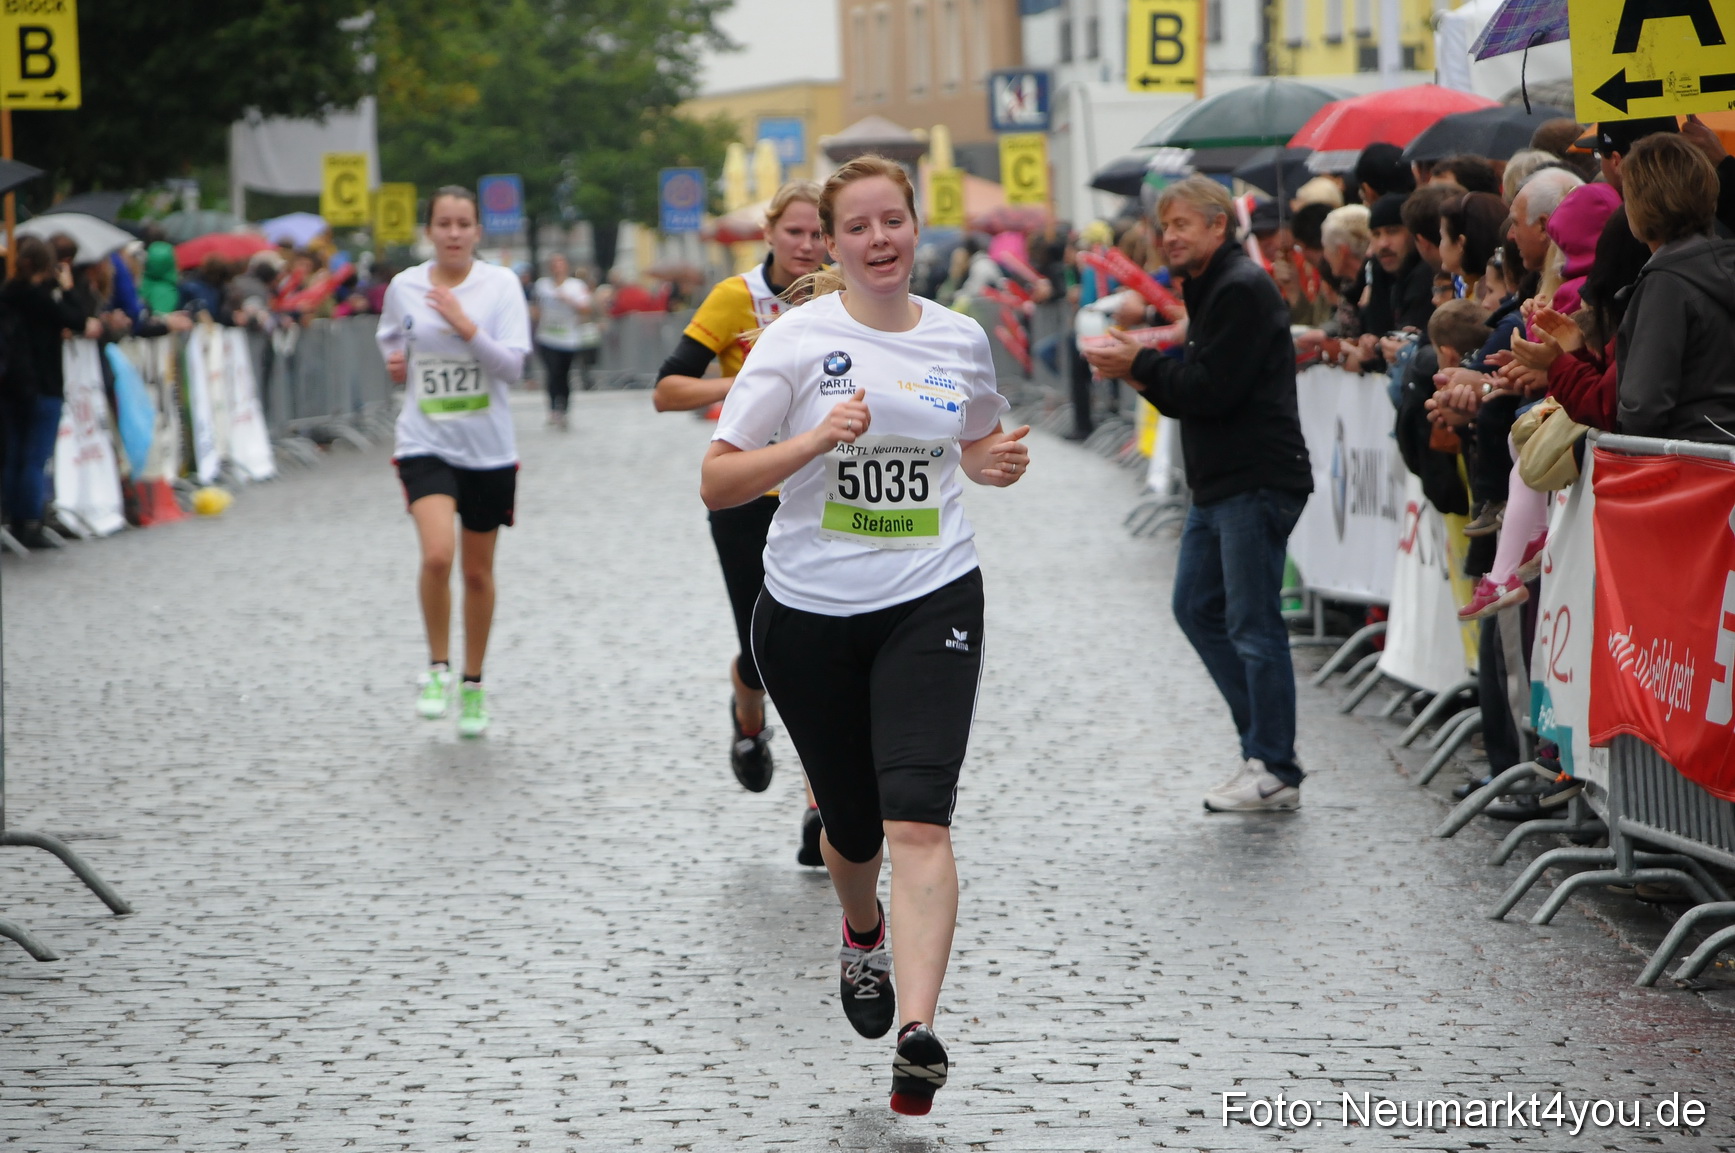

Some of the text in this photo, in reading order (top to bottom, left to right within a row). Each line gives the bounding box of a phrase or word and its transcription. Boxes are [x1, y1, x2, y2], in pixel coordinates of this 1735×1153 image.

[1151, 13, 1185, 65] B
[1612, 0, 1726, 54] A
[19, 26, 57, 79] B
[332, 172, 359, 207] C
[1012, 154, 1036, 191] C
[423, 367, 481, 394] 5127
[820, 379, 856, 389] PARTL
[820, 387, 857, 396] Neumarkt
[835, 443, 926, 456] ARTL Neumarkt
[838, 459, 930, 503] 5035
[851, 512, 914, 532] Stefanie
[1649, 637, 1673, 702] Geld
[1665, 647, 1695, 722] geht
